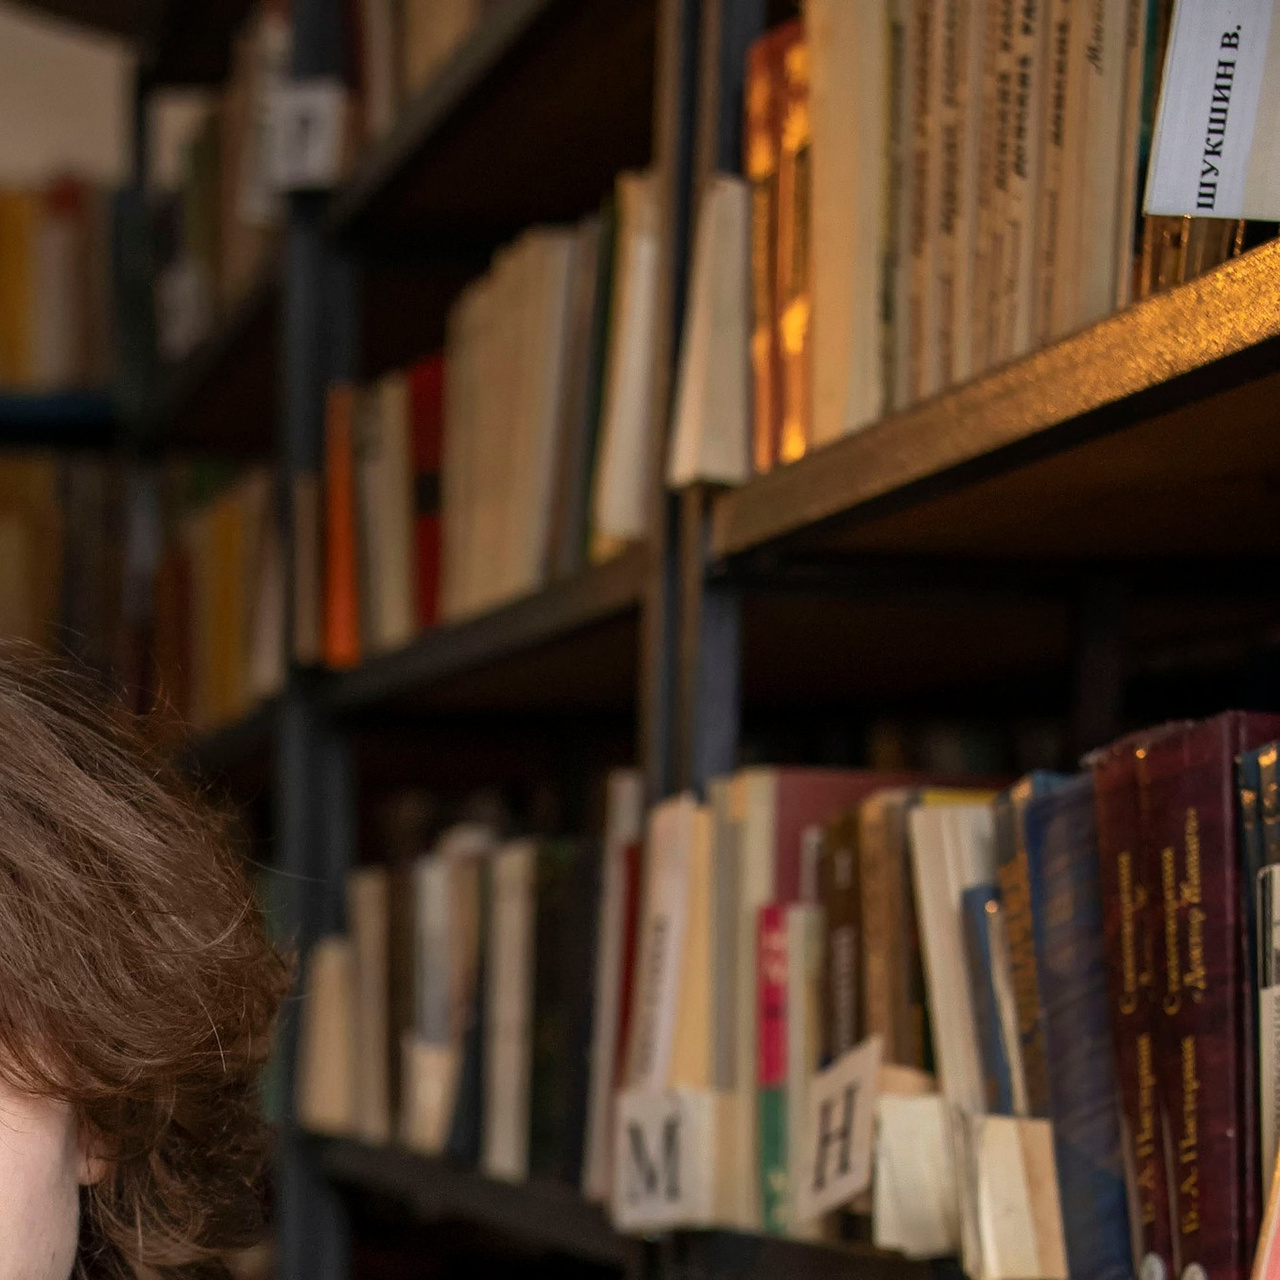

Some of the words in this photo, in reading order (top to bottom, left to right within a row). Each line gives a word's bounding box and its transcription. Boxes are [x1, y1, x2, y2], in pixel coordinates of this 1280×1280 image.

[1196, 59, 1236, 211] ШУКШИН
[1220, 24, 1242, 51] В.
[624, 1111, 682, 1205] М
[811, 1078, 861, 1192] Н
